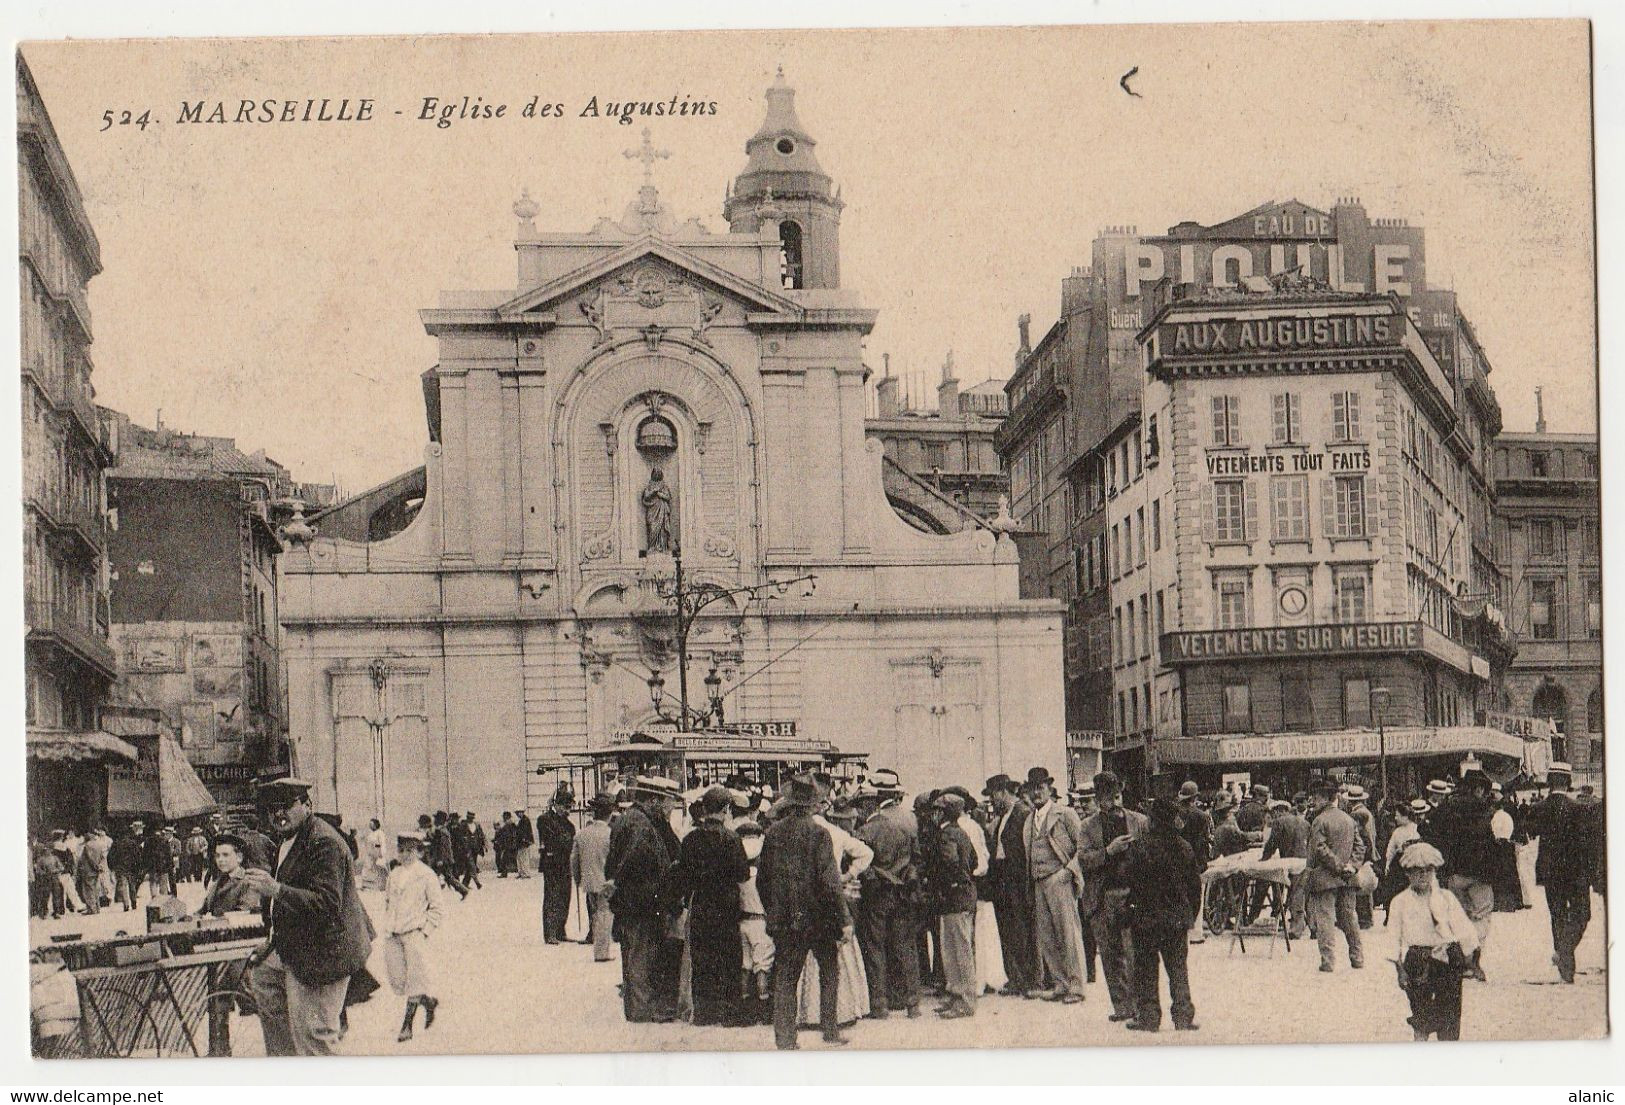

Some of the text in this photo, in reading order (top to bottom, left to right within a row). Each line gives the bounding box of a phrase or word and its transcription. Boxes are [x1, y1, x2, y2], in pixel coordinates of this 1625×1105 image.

[1254, 215, 1330, 235] EAU DE
[1174, 315, 1391, 351] AUX AUGUSTINS
[1292, 453, 1325, 471] TOUT
[1332, 450, 1371, 470] FAITS
[1296, 628, 1333, 649] SUR
[1340, 623, 1418, 647] MESURE
[1279, 738, 1326, 755] MAISON
[1331, 735, 1355, 753] DES
